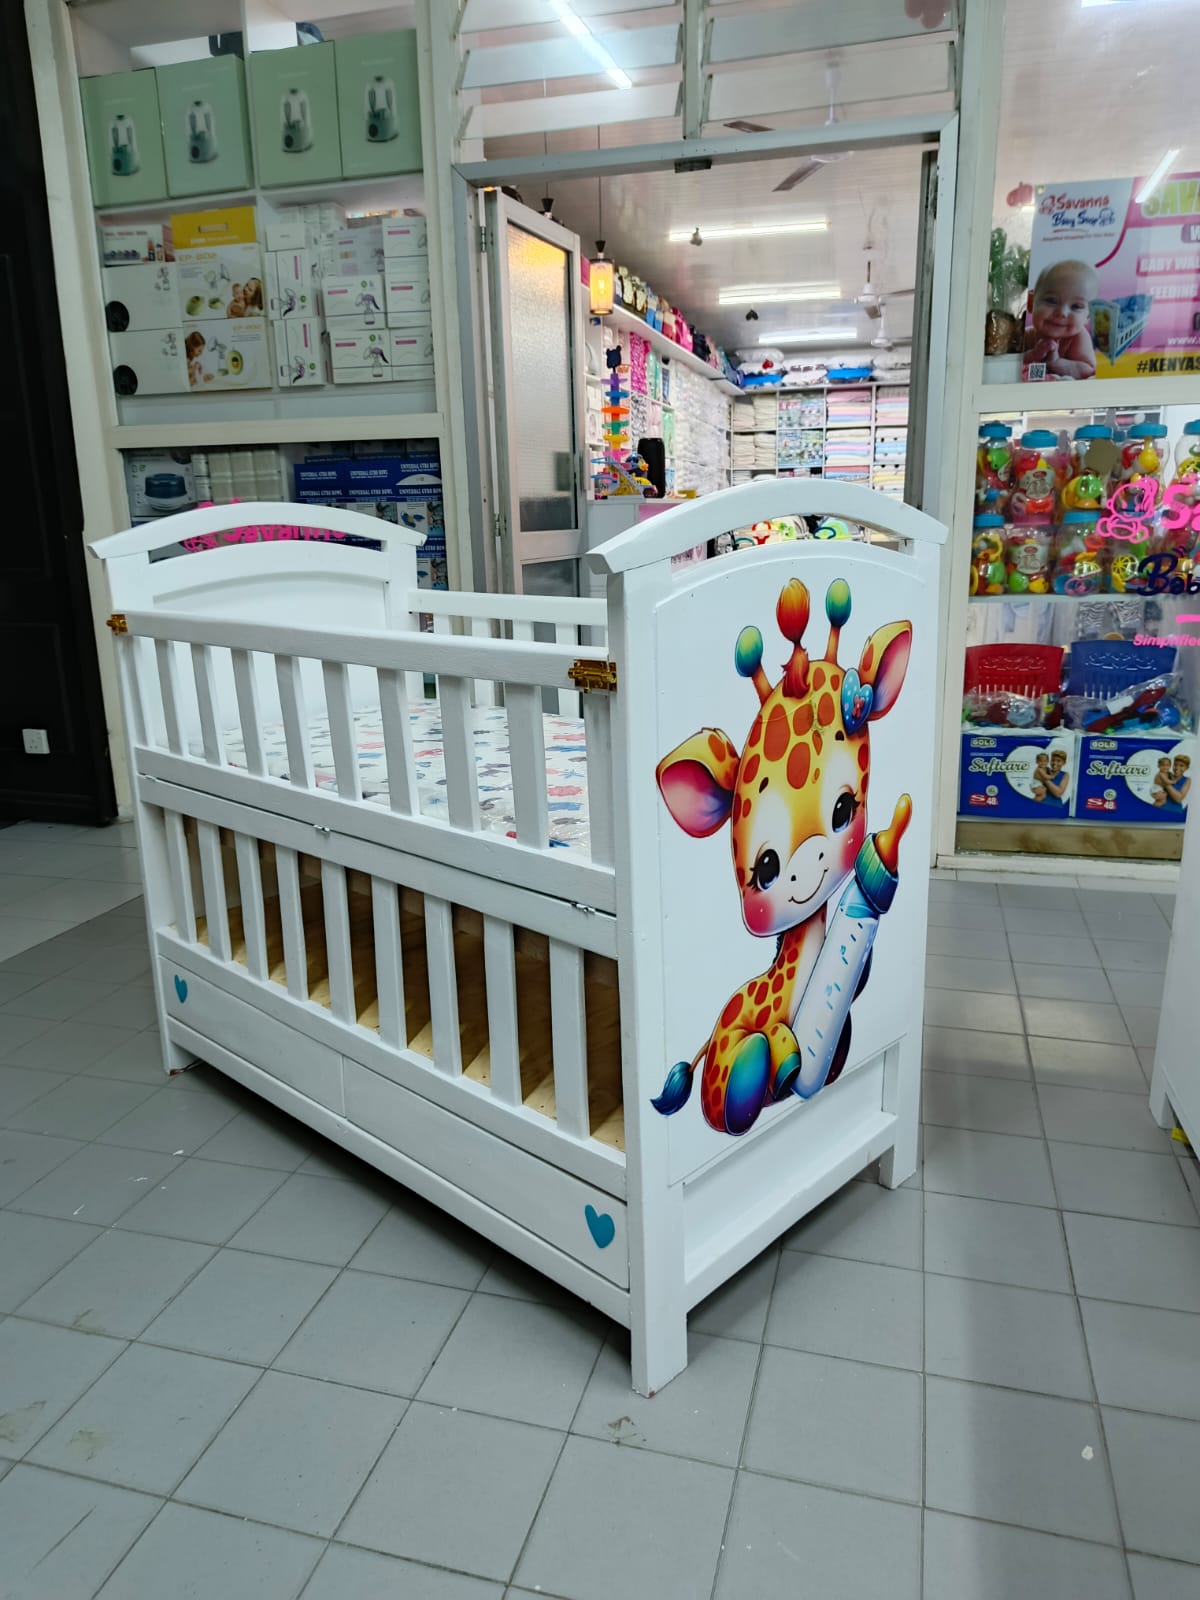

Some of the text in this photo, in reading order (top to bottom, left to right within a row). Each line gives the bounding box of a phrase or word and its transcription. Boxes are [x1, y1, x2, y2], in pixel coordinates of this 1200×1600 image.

[1056, 192, 1110, 210] Savanna
[1140, 258, 1173, 273] BABY
[972, 738, 996, 746] GOLD
[1091, 741, 1116, 749] GOLD
[969, 757, 1030, 776] Softcare
[1087, 760, 1150, 779] Softcare
